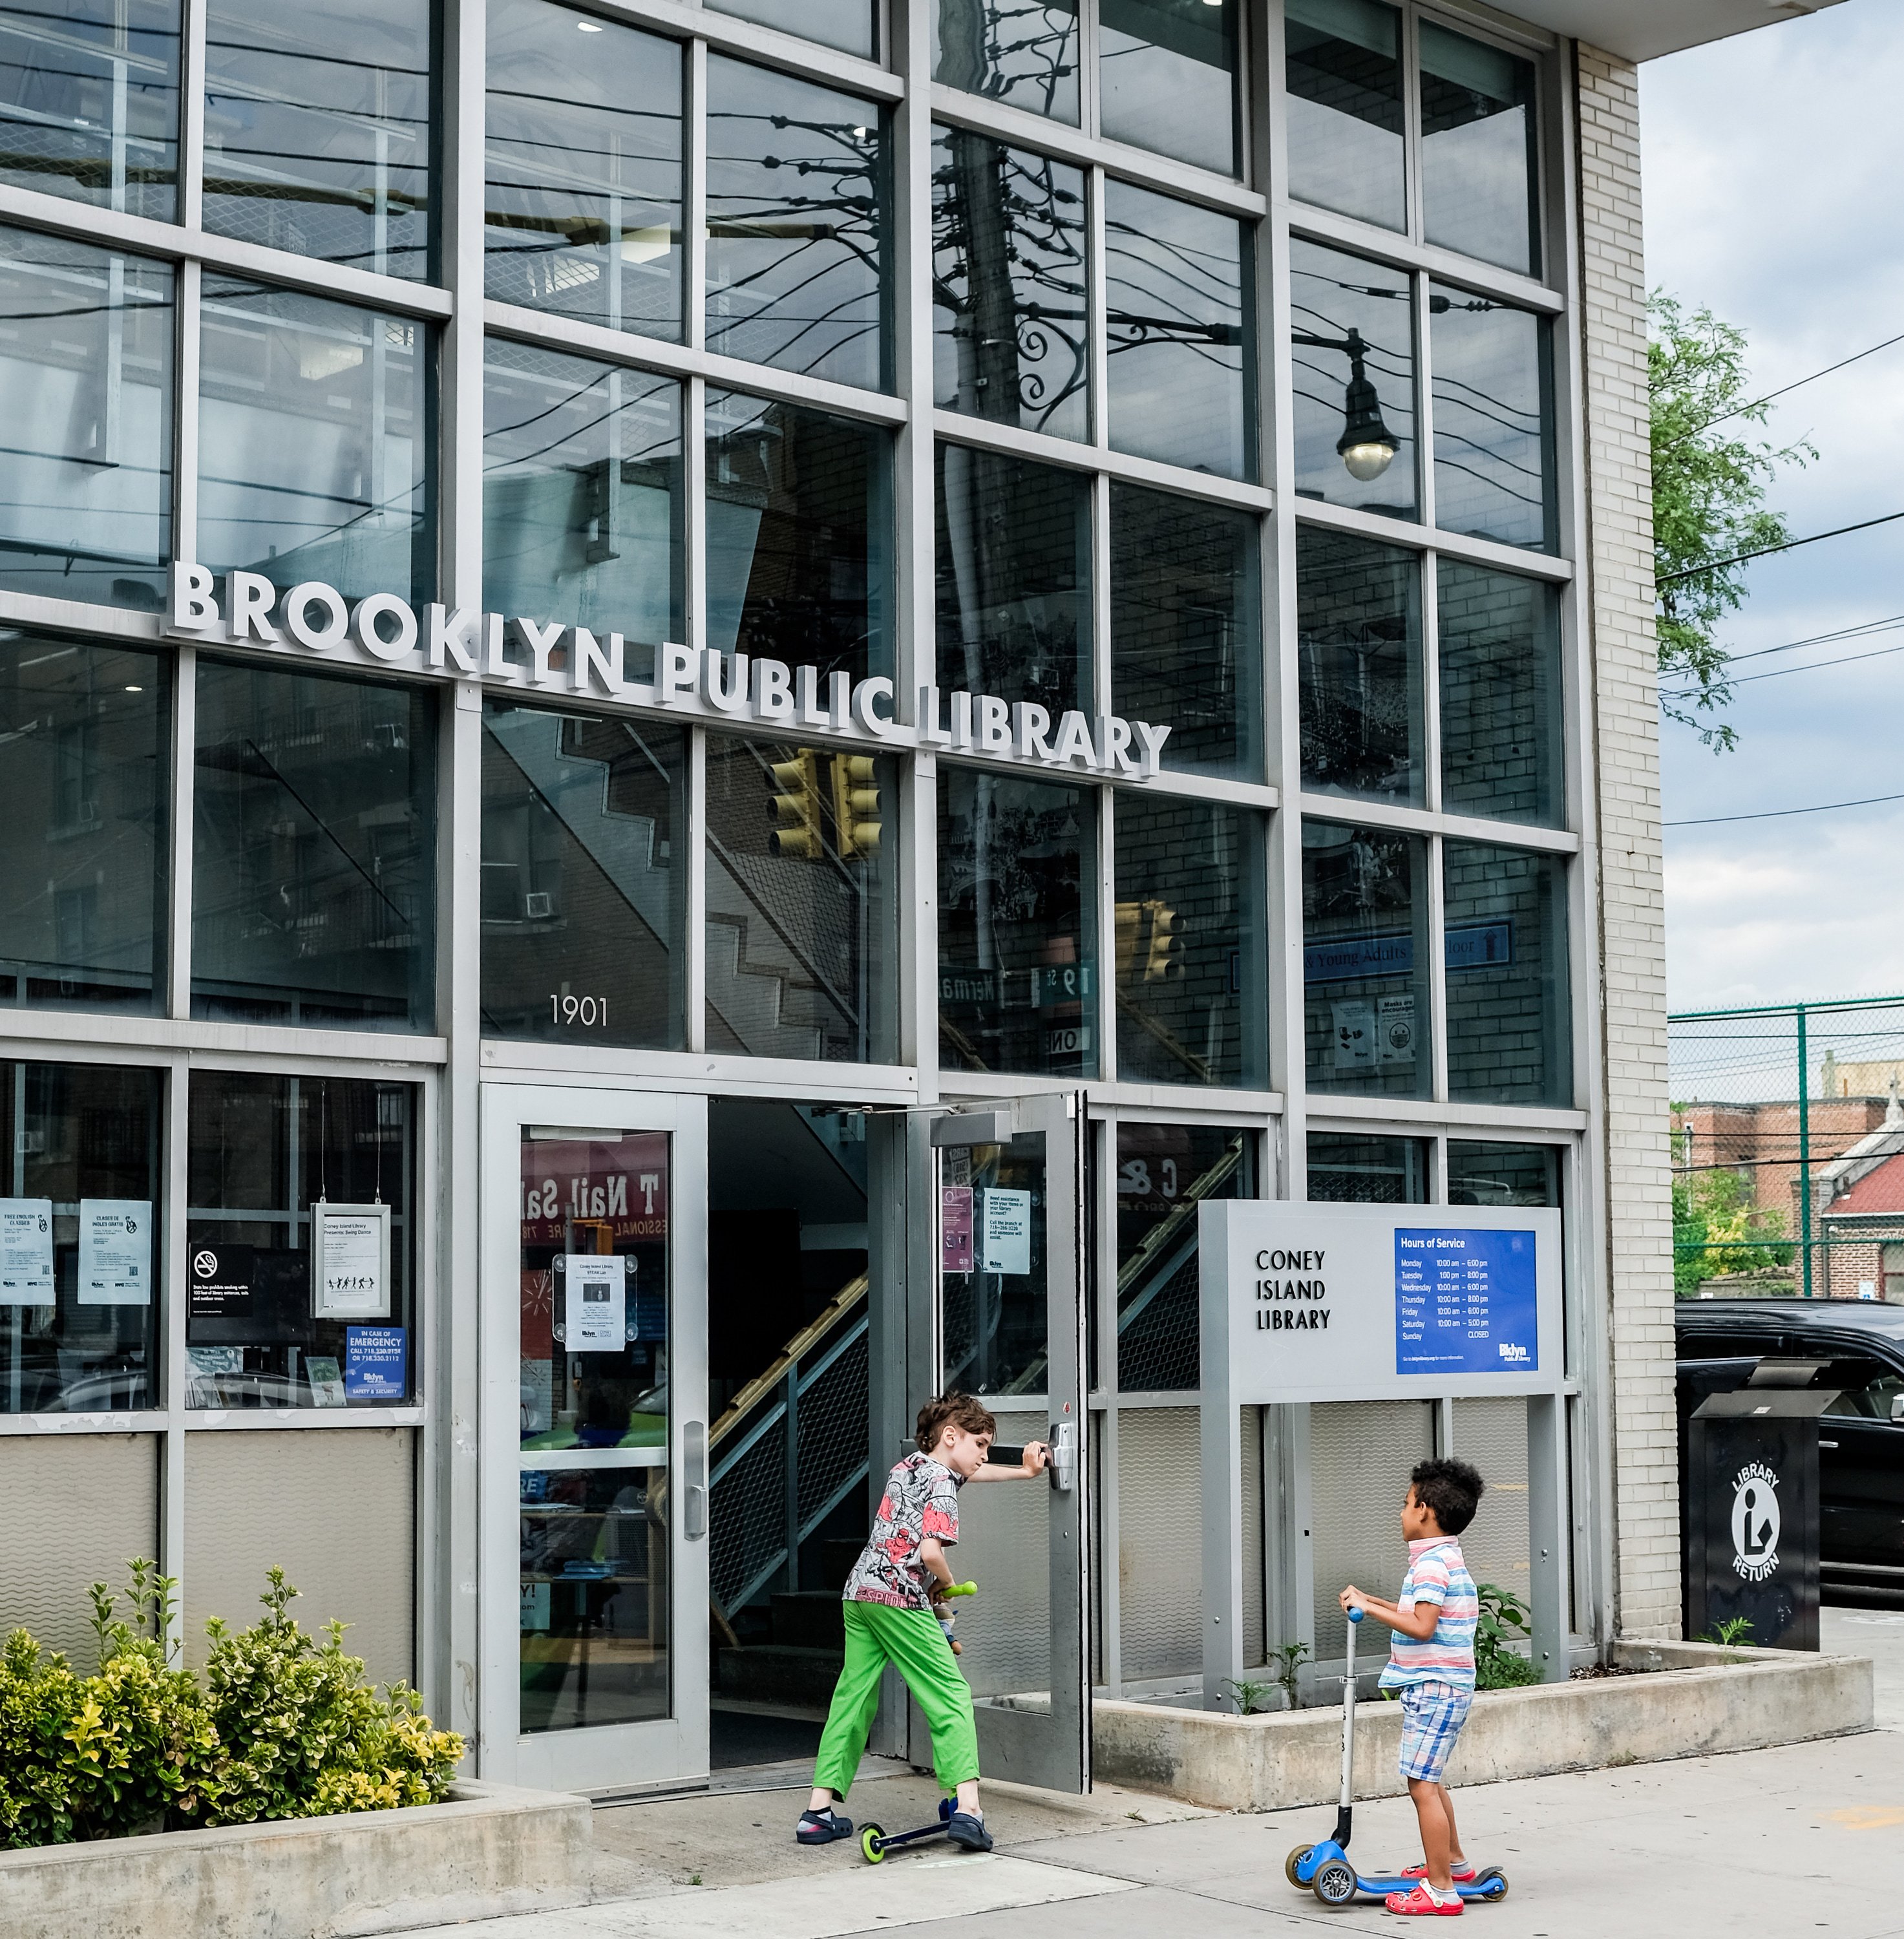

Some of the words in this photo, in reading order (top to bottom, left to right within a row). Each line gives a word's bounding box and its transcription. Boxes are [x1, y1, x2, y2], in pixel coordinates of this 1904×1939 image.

[168, 560, 624, 694] BROOKLYN
[655, 644, 893, 736] PUBLIC
[919, 685, 1172, 777] LIBRARY
[1305, 955, 1314, 968] &
[1318, 953, 1359, 968] Young
[1363, 946, 1406, 962] Adults
[550, 994, 608, 1026] 1901
[1401, 1237, 1425, 1248] Hours
[1427, 1238, 1435, 1248] of
[1436, 1237, 1466, 1248] Service
[1256, 1250, 1325, 1271] CONEY
[1401, 1259, 1422, 1269] Monday
[1401, 1271, 1423, 1281] Tuesday
[1256, 1280, 1326, 1300] ISLAND
[1401, 1284, 1432, 1293] Wednesday
[1402, 1296, 1426, 1305] Thursday
[1256, 1309, 1331, 1330] LIBRARY
[1402, 1308, 1418, 1317] Friday
[1402, 1320, 1426, 1329] Saturday
[350, 1337, 402, 1347] EMERGENCY
[1402, 1332, 1422, 1342] Sunday
[1499, 1343, 1527, 1362] Bklyn
[1731, 1463, 1780, 1492] LIBRARY
[1732, 1552, 1780, 1582] RETURN
